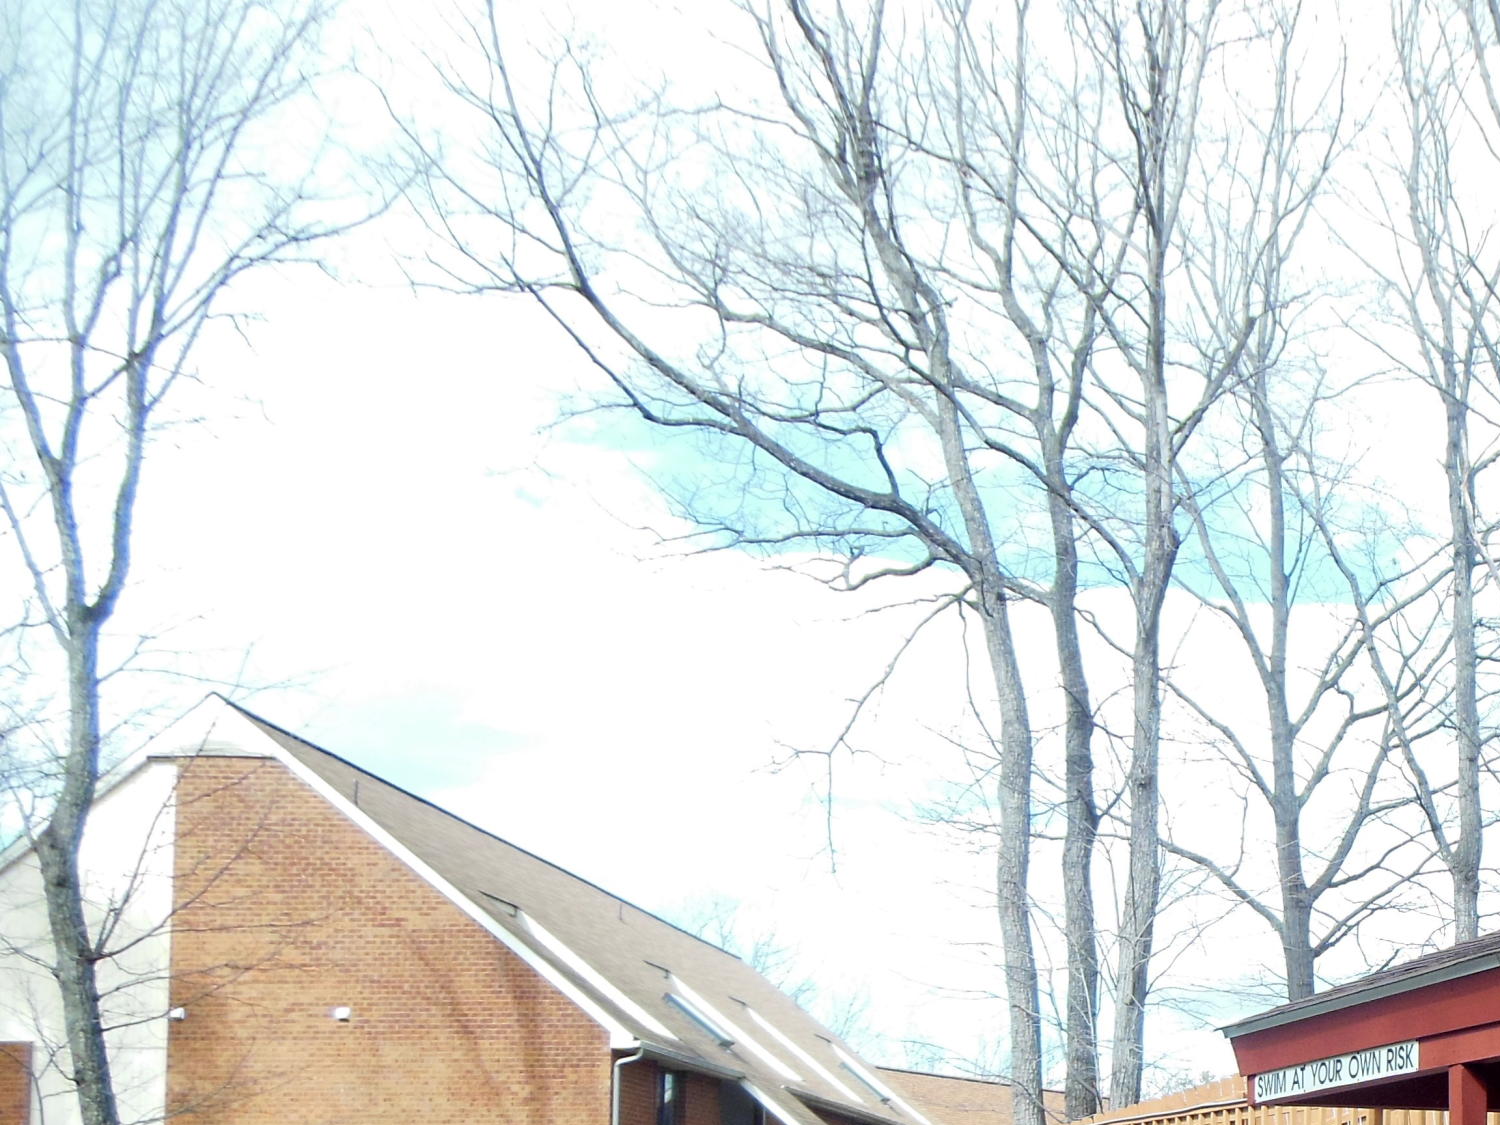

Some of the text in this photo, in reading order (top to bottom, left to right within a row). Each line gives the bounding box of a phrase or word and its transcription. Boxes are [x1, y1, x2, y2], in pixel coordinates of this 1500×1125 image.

[1257, 1044, 1414, 1098] SWIM AT YOUR OWN RISK
